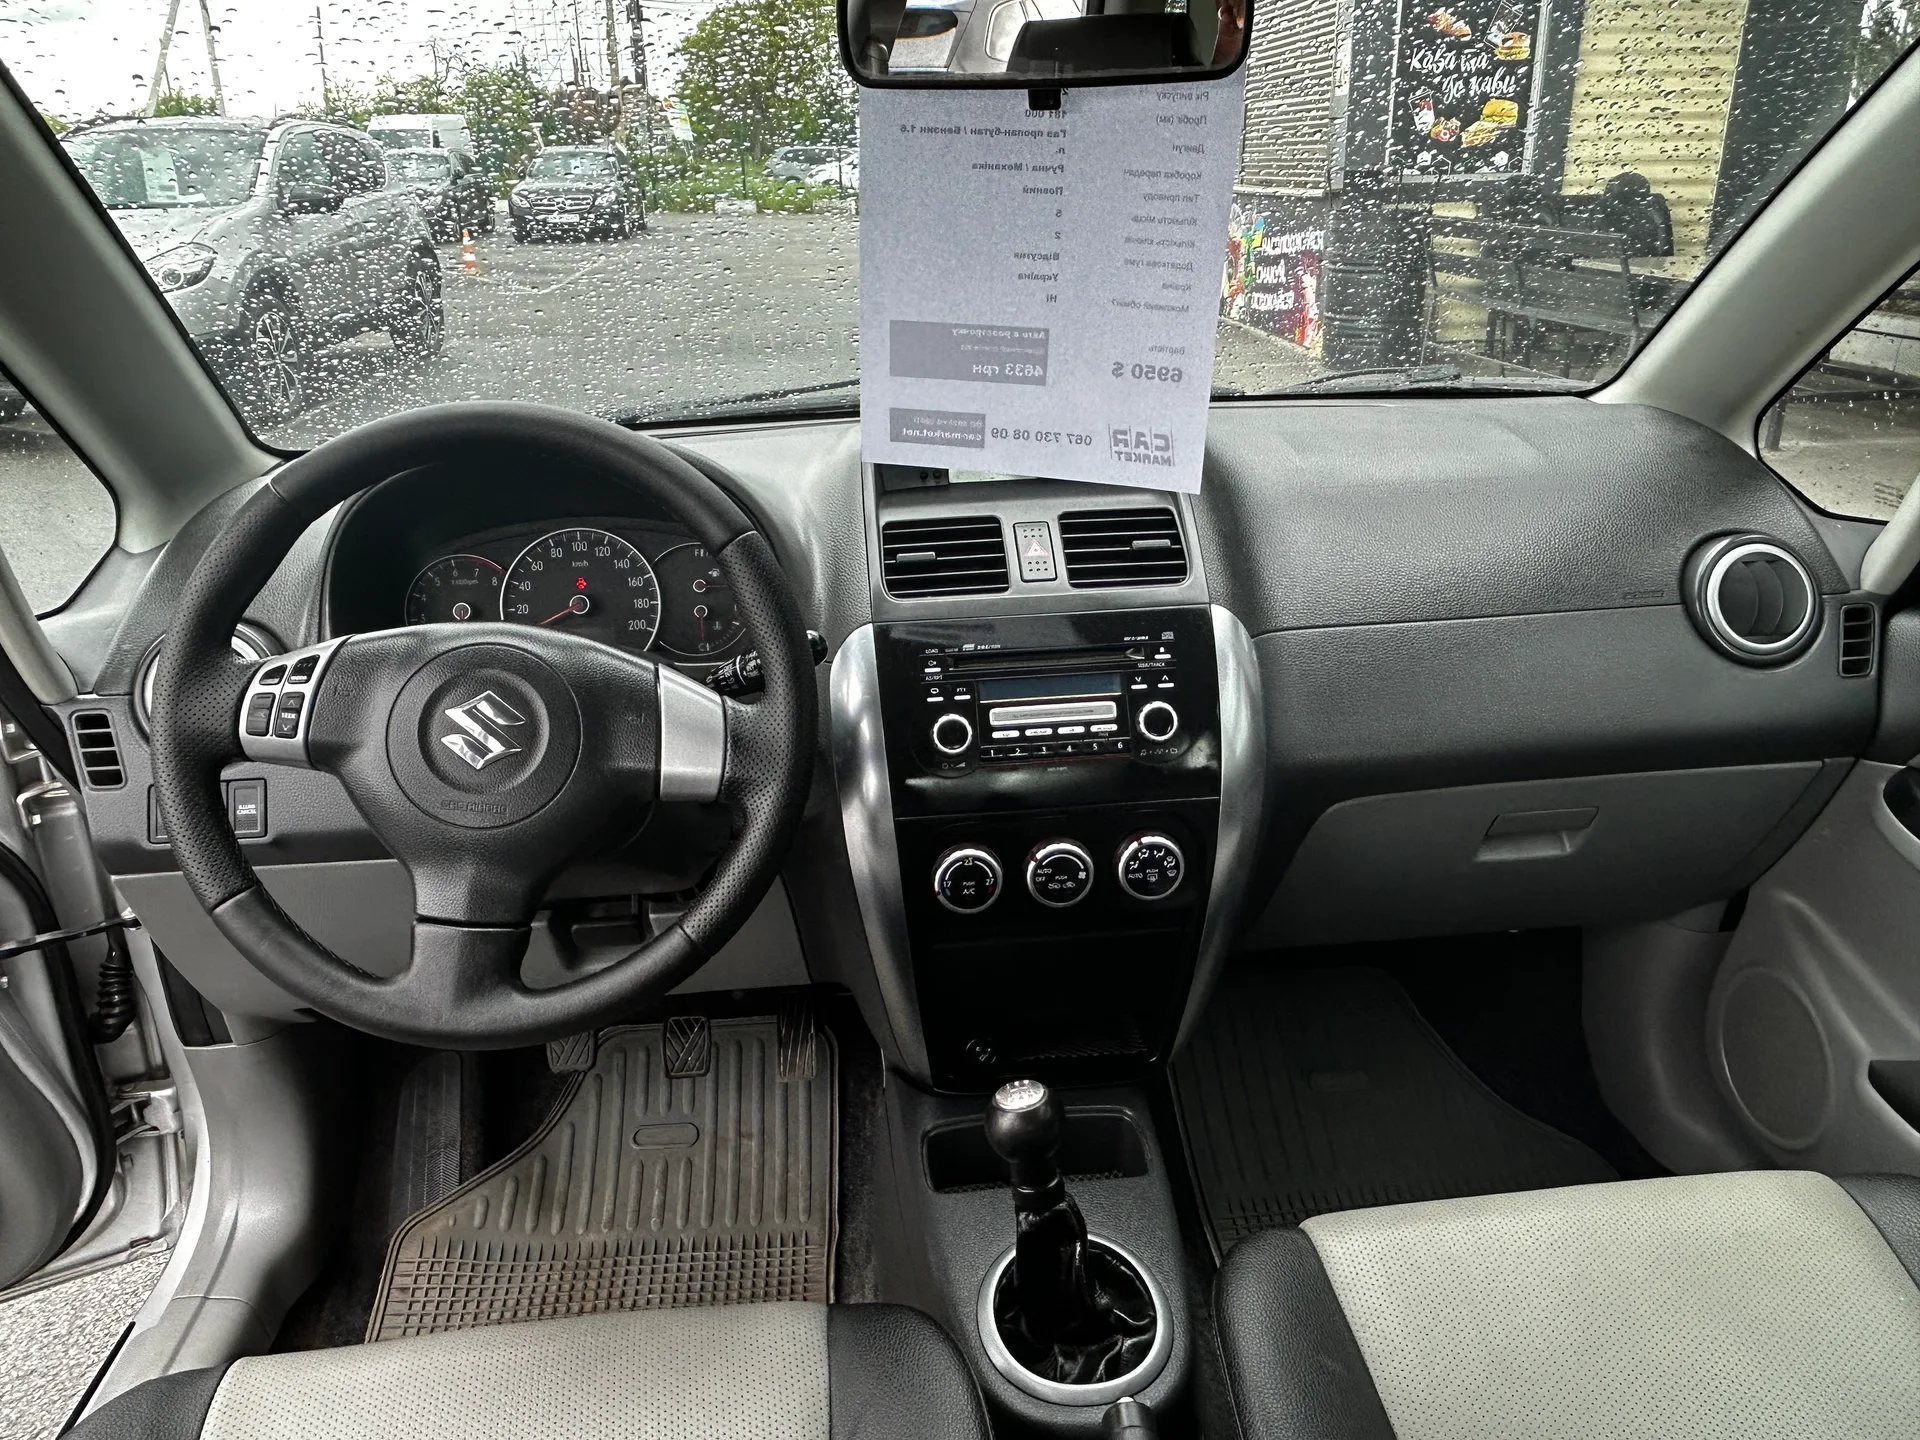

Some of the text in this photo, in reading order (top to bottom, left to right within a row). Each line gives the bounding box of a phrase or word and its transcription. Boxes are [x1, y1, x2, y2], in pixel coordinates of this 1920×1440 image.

[571, 541, 588, 552] 100
[595, 546, 611, 557] 120
[550, 547, 563, 558] 80
[530, 560, 544, 571] 60
[571, 560, 589, 568] km/h
[614, 558, 630, 569] 140
[491, 576, 498, 586] 8
[519, 581, 531, 591] 40
[628, 576, 644, 587] 160
[517, 603, 529, 614] 20
[633, 598, 650, 609] 180
[628, 619, 647, 631] 200
[985, 878, 994, 886] 27
